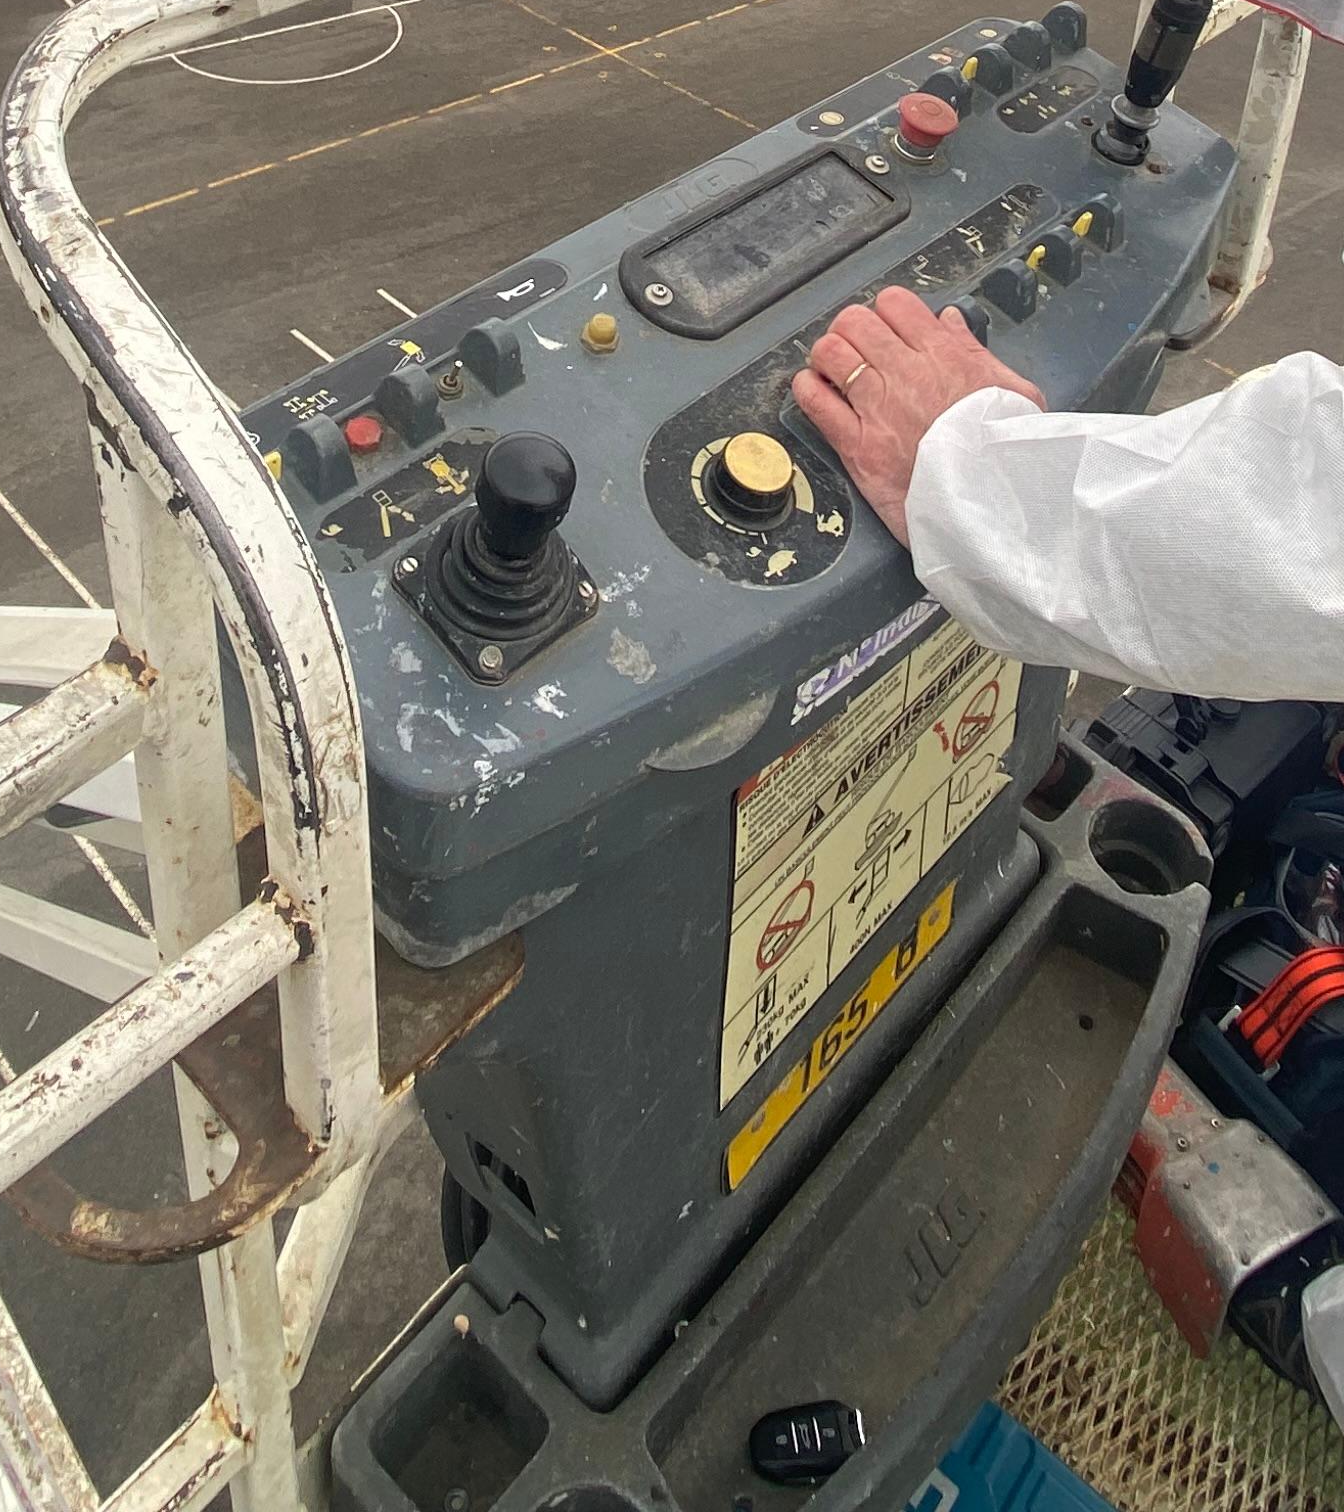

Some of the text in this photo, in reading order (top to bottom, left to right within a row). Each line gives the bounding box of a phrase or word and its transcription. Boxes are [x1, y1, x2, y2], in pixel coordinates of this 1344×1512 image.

[873, 902, 893, 928] MAX
[788, 971, 810, 1005] MAX
[800, 986, 870, 1094] 165
